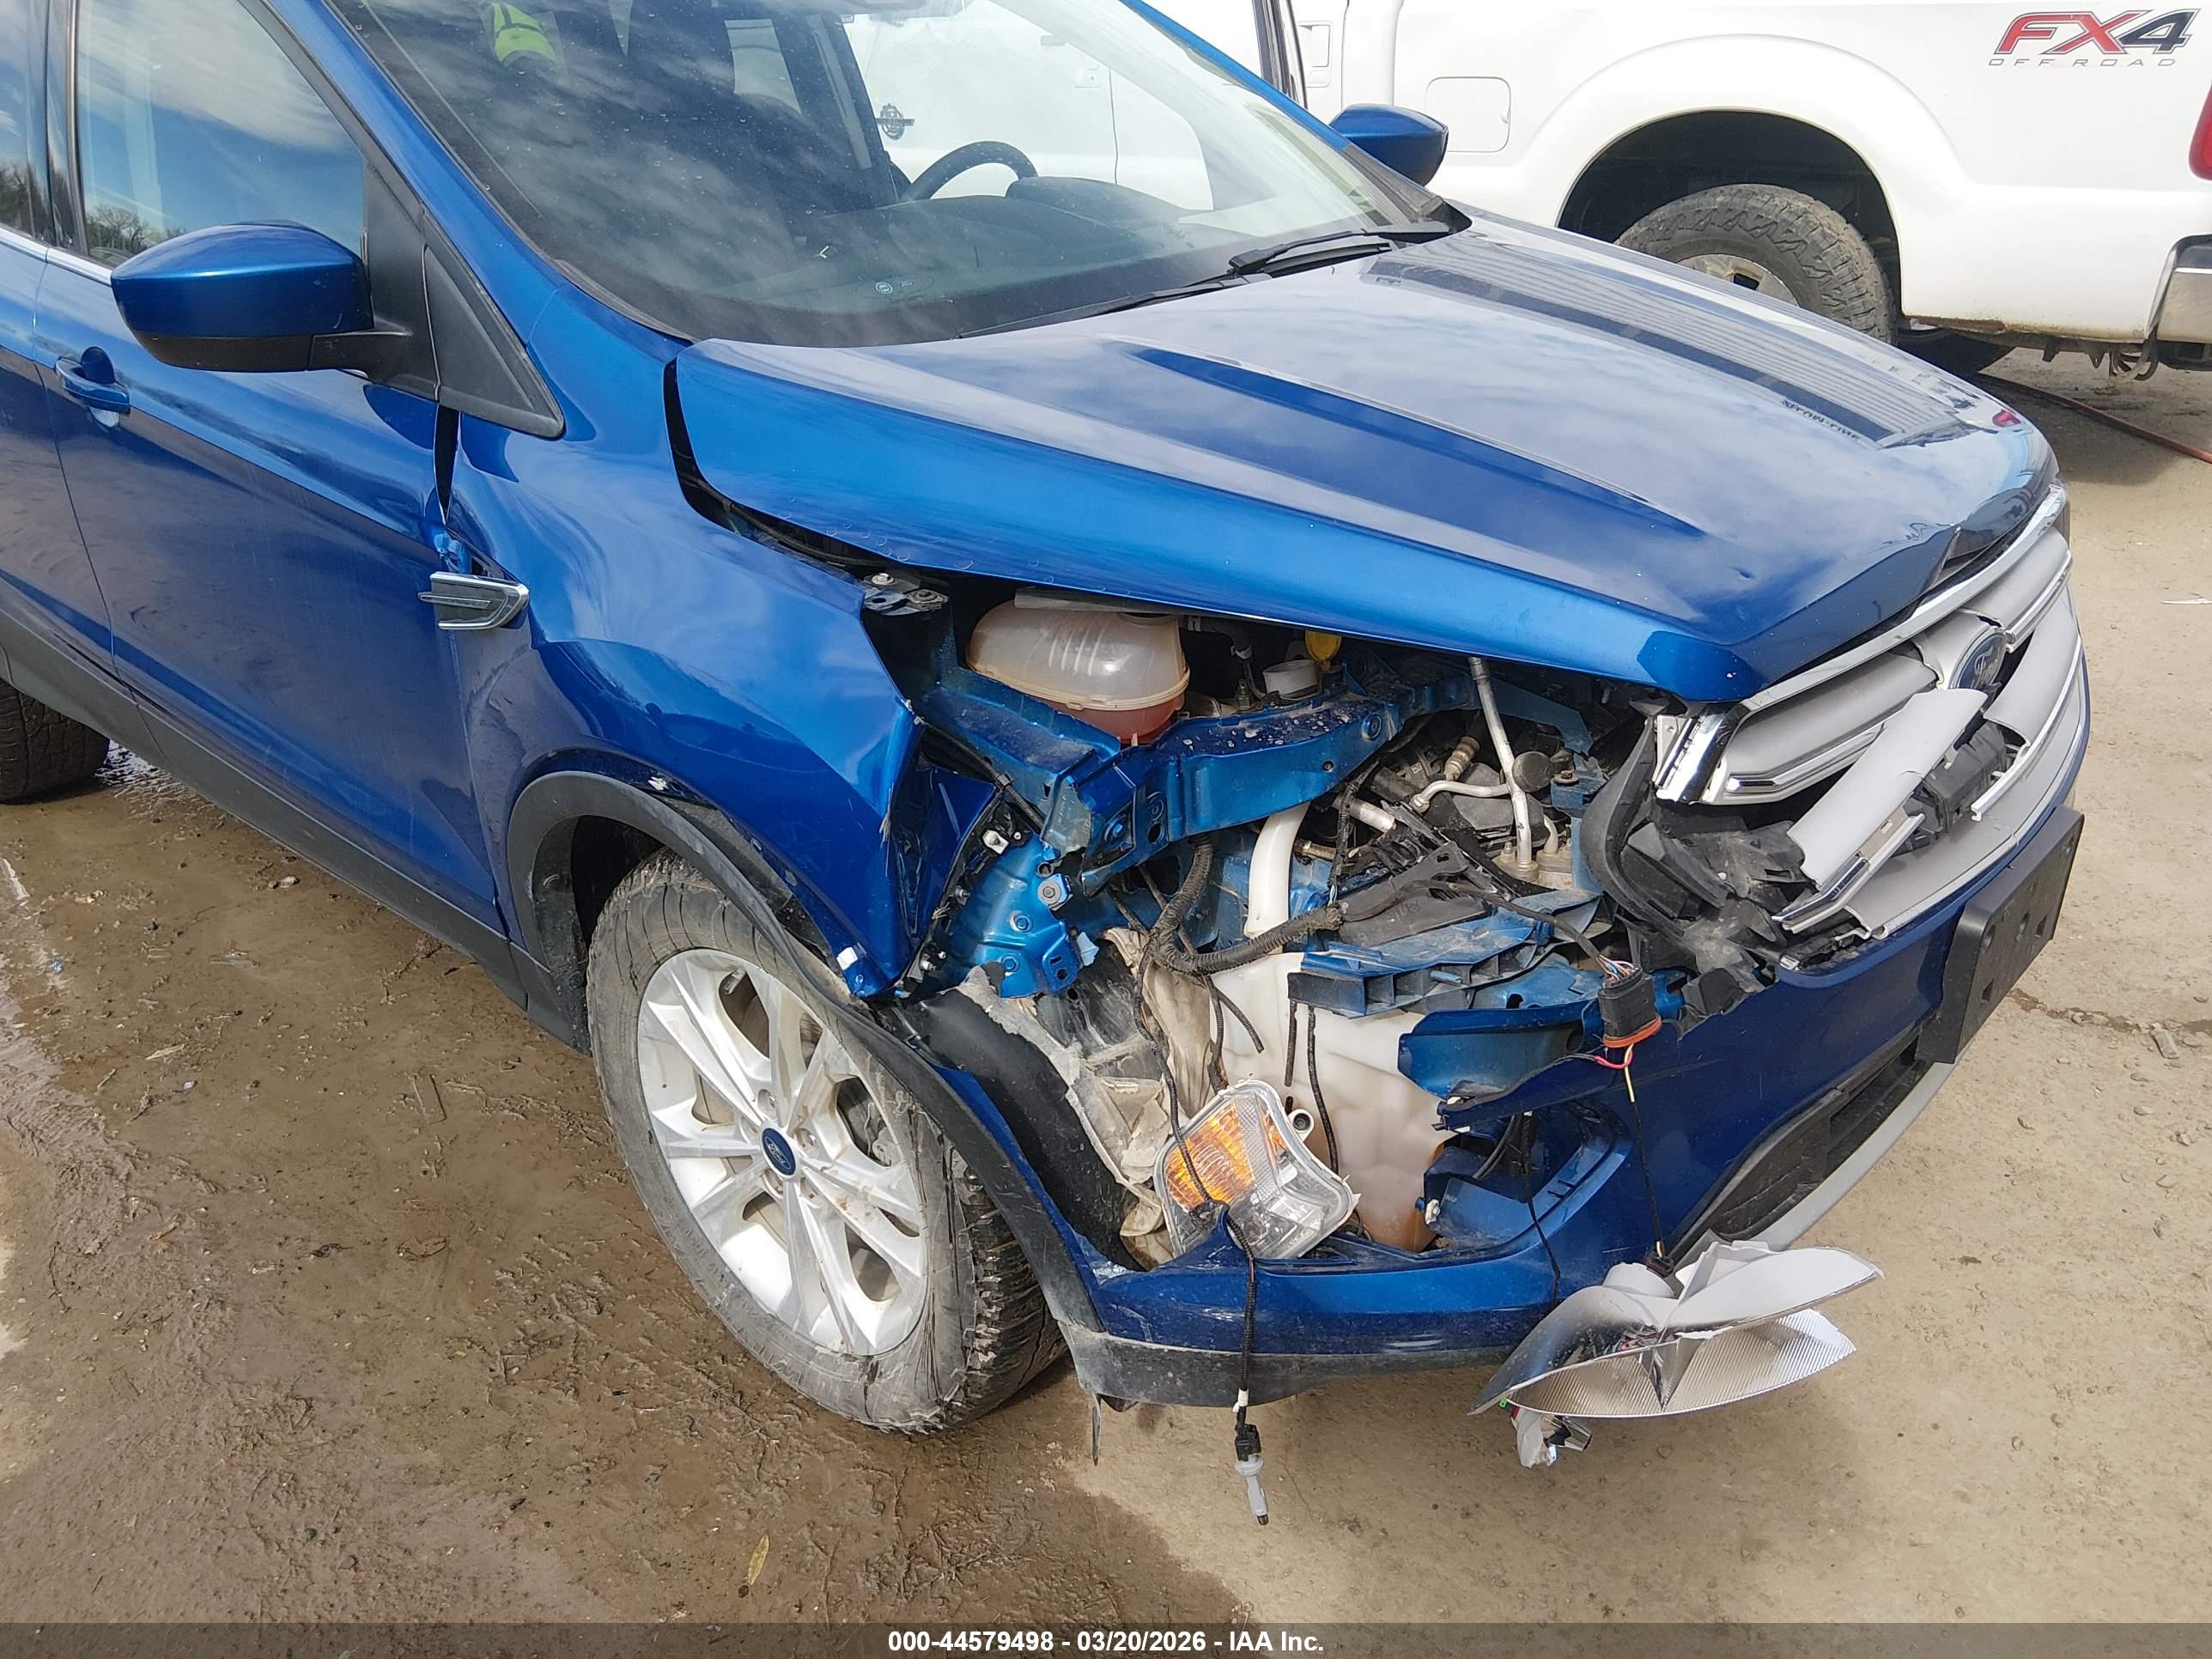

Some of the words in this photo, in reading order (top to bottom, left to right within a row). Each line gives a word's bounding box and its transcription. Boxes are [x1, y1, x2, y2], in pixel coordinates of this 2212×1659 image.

[1993, 8, 2201, 54] FX4
[1988, 58, 2056, 67] OFF
[2071, 58, 2177, 67] ROAD
